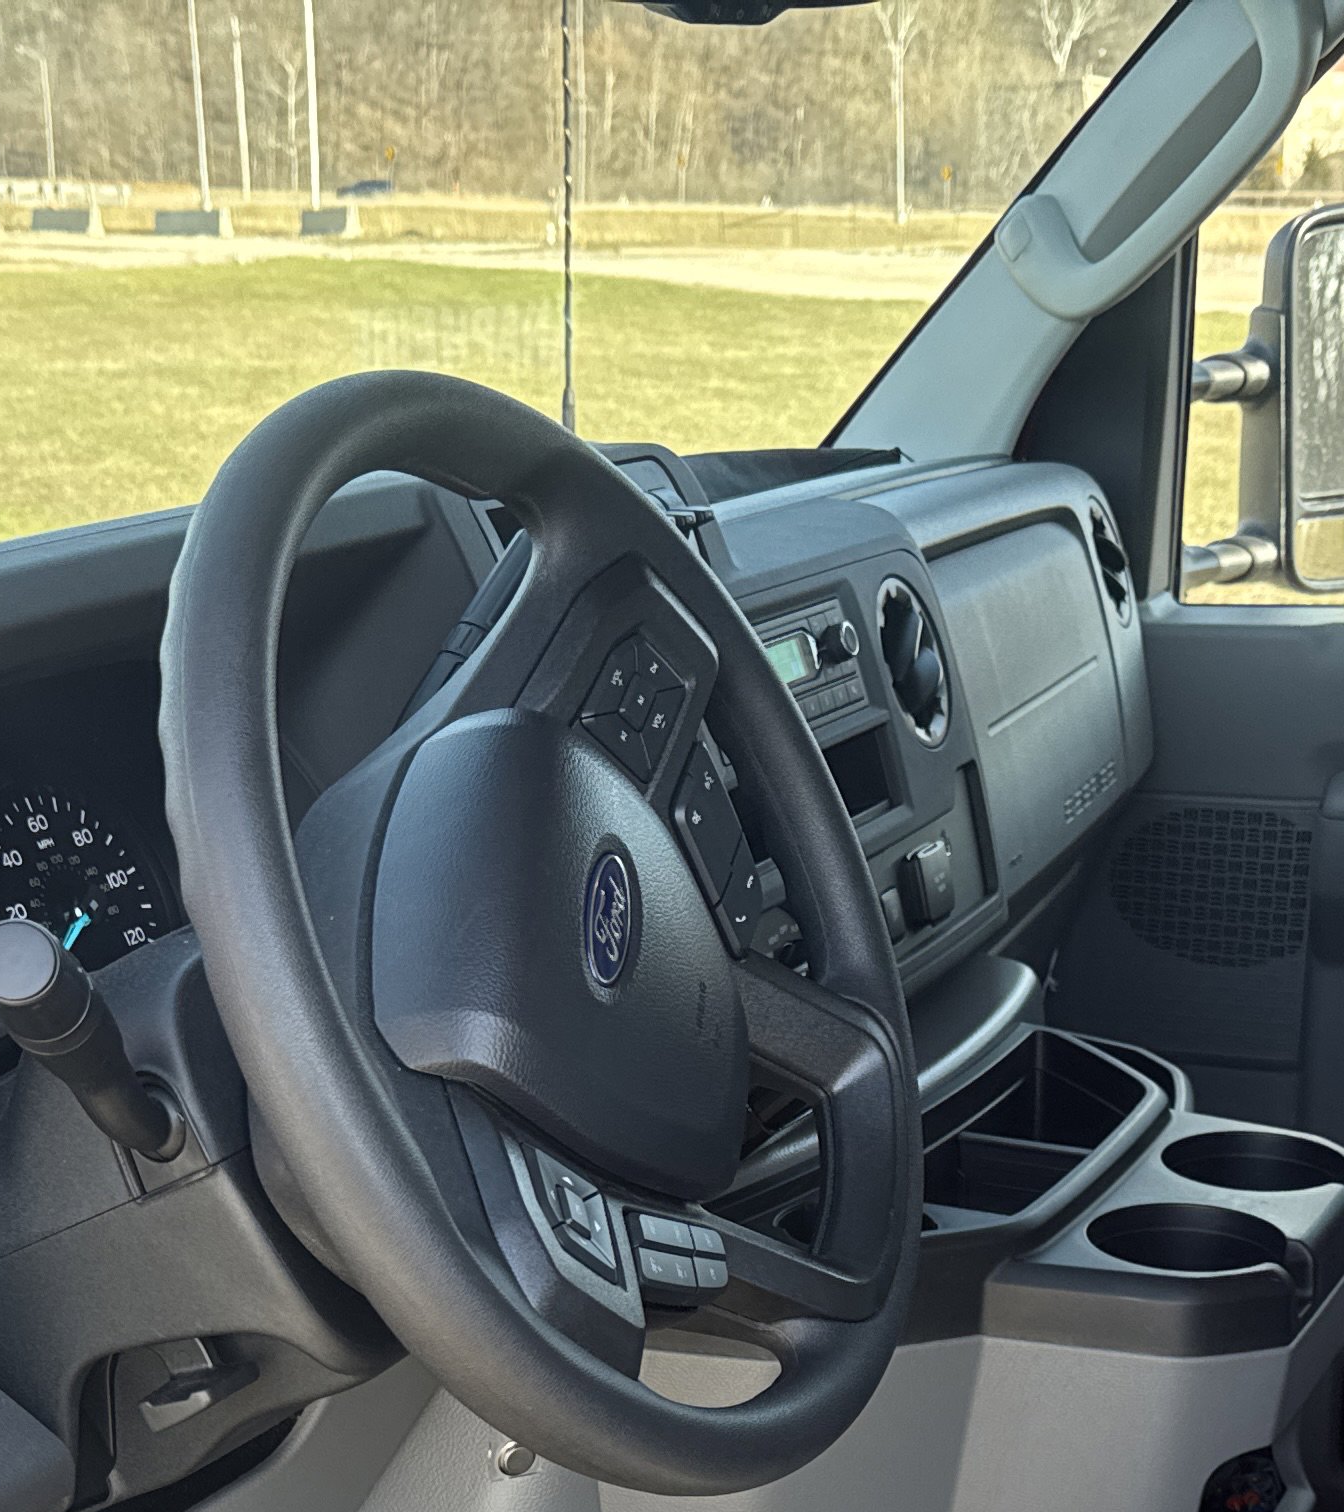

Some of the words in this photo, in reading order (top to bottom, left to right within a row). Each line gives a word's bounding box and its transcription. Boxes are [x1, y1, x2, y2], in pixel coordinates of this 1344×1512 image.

[27, 814, 49, 833] 60
[36, 837, 56, 851] MPH
[71, 828, 94, 847] 80
[2, 850, 23, 868] 40
[105, 869, 129, 890] 100
[5, 903, 28, 920] 20
[594, 875, 626, 962] Ford
[123, 926, 147, 947] 120
